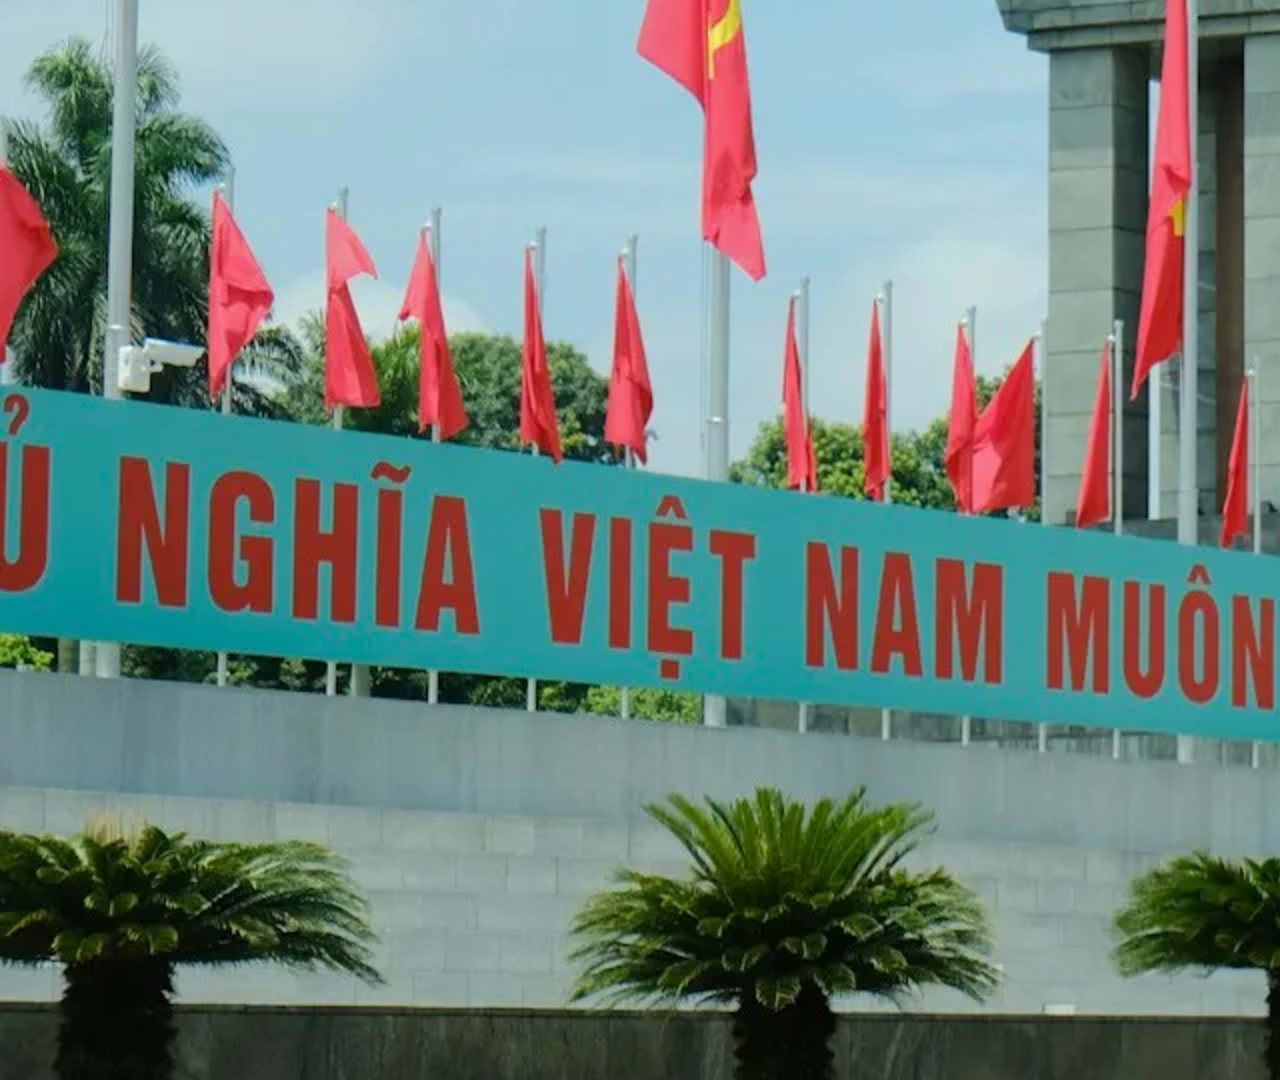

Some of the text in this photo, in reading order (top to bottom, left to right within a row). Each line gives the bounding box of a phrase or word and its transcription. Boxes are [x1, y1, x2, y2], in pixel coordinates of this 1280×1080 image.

[115, 455, 480, 636] NGHĨA
[539, 494, 756, 680] VIỆT
[806, 541, 1003, 684] NAM
[1046, 565, 1275, 710] MUÔN
